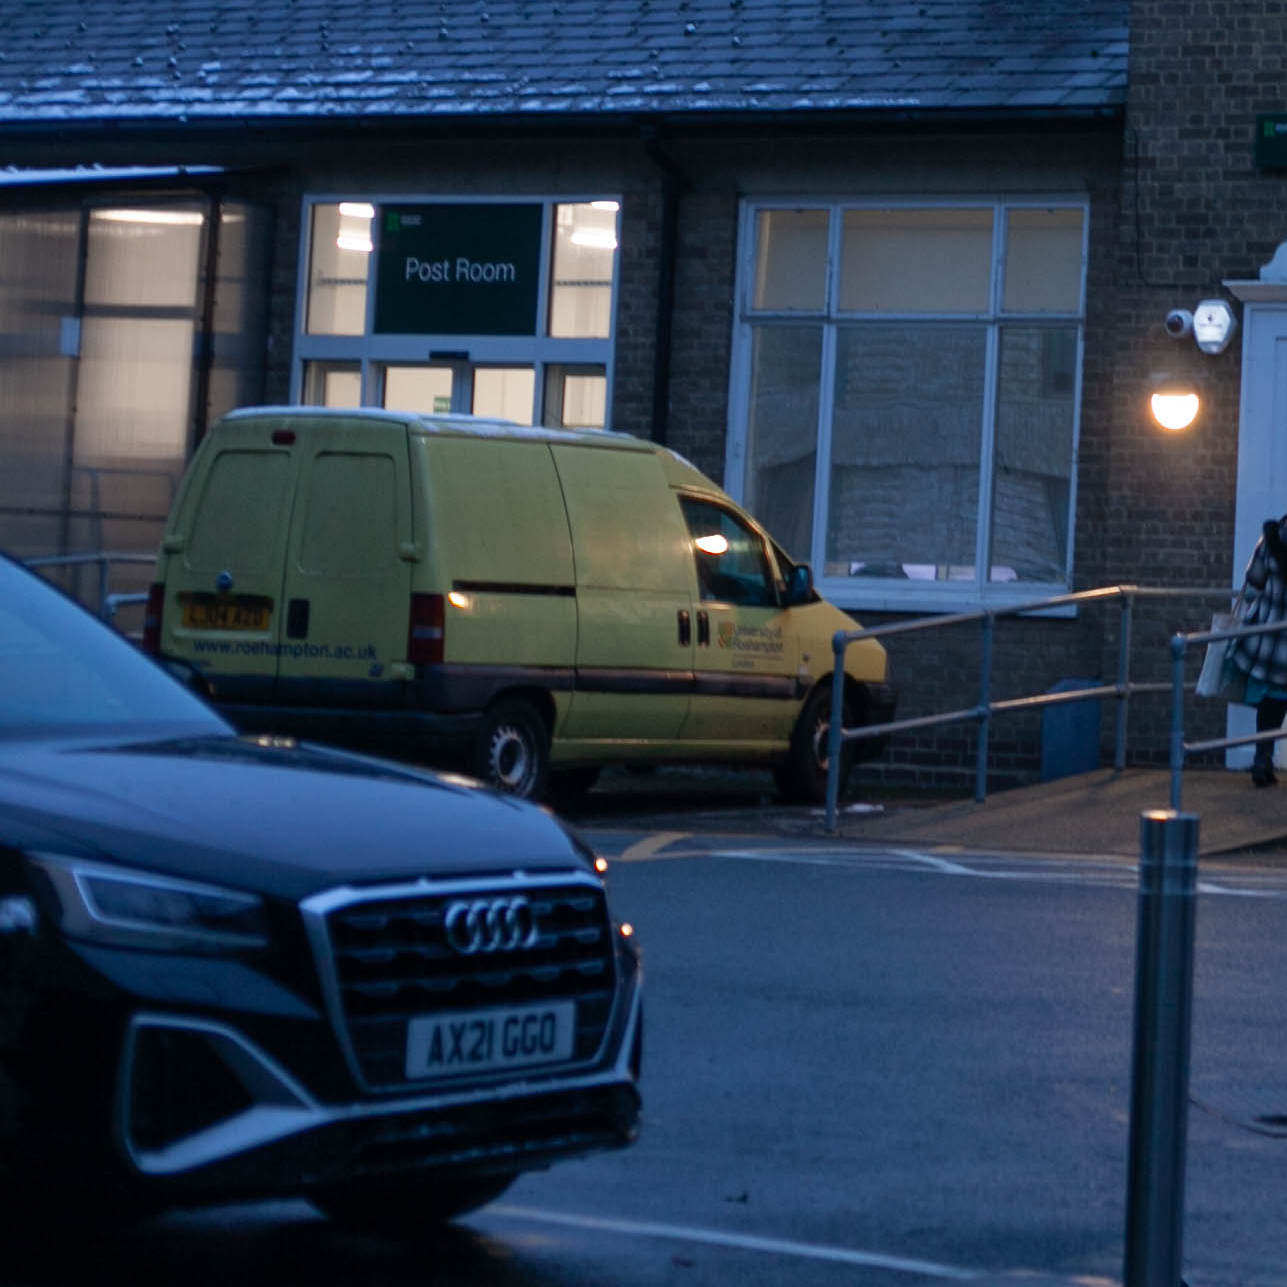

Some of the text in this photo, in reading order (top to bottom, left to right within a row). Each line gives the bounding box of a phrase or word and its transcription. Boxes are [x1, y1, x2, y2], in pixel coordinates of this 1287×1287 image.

[406, 256, 516, 282] Post Room
[193, 639, 377, 660] www.roehampton.ac.uk
[427, 1018, 494, 1066] AX21
